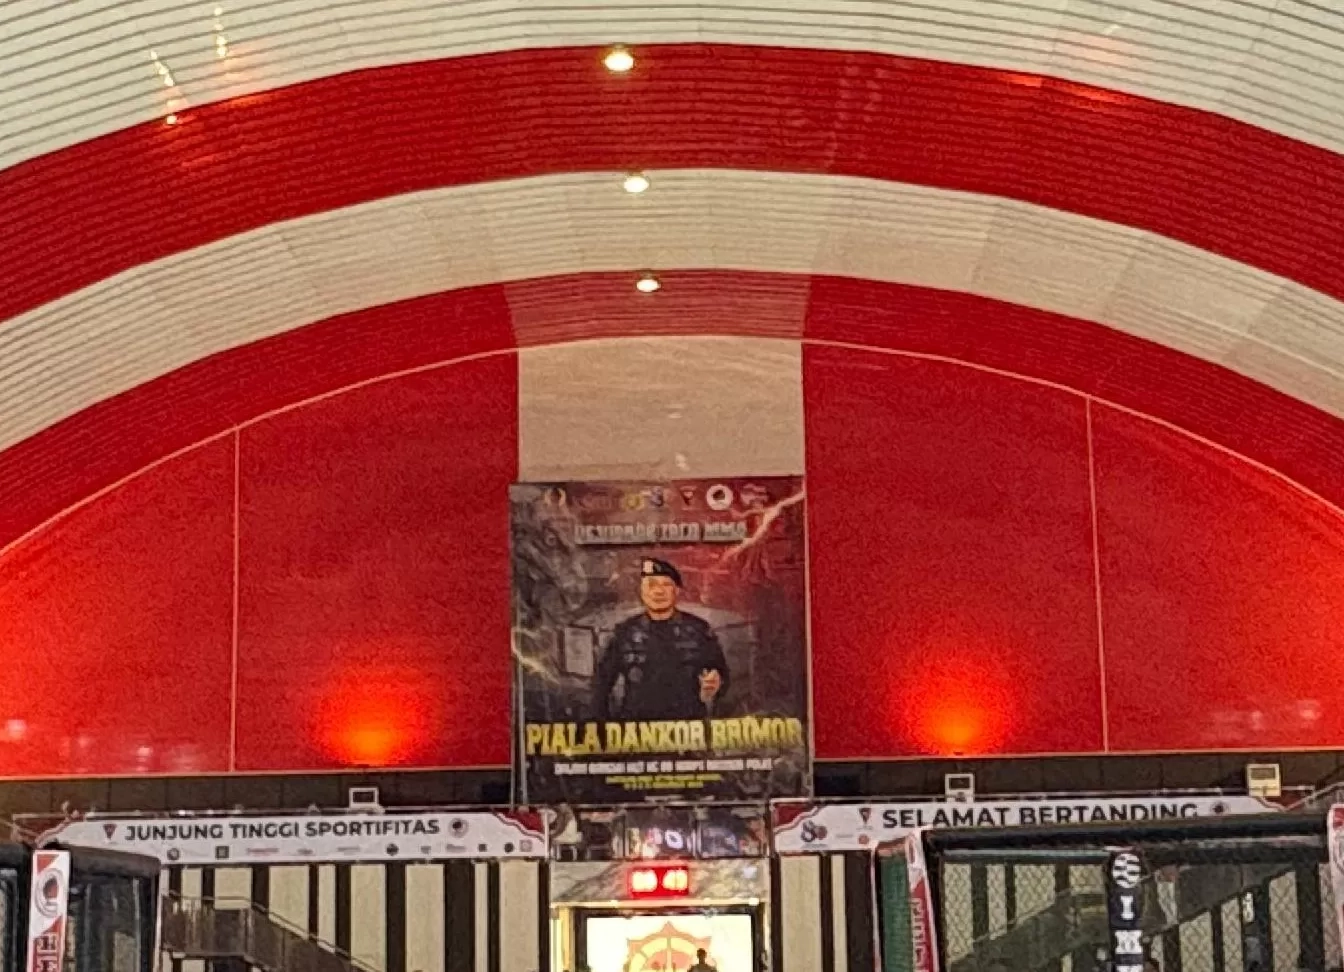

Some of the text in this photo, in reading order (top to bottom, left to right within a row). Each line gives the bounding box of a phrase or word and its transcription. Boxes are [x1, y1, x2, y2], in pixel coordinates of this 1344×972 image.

[526, 722, 601, 755] PIALA
[882, 803, 1197, 829] SELAMAT BERTANDING
[125, 819, 440, 840] JUNJUNG TINGGI SPORTIFITAS
